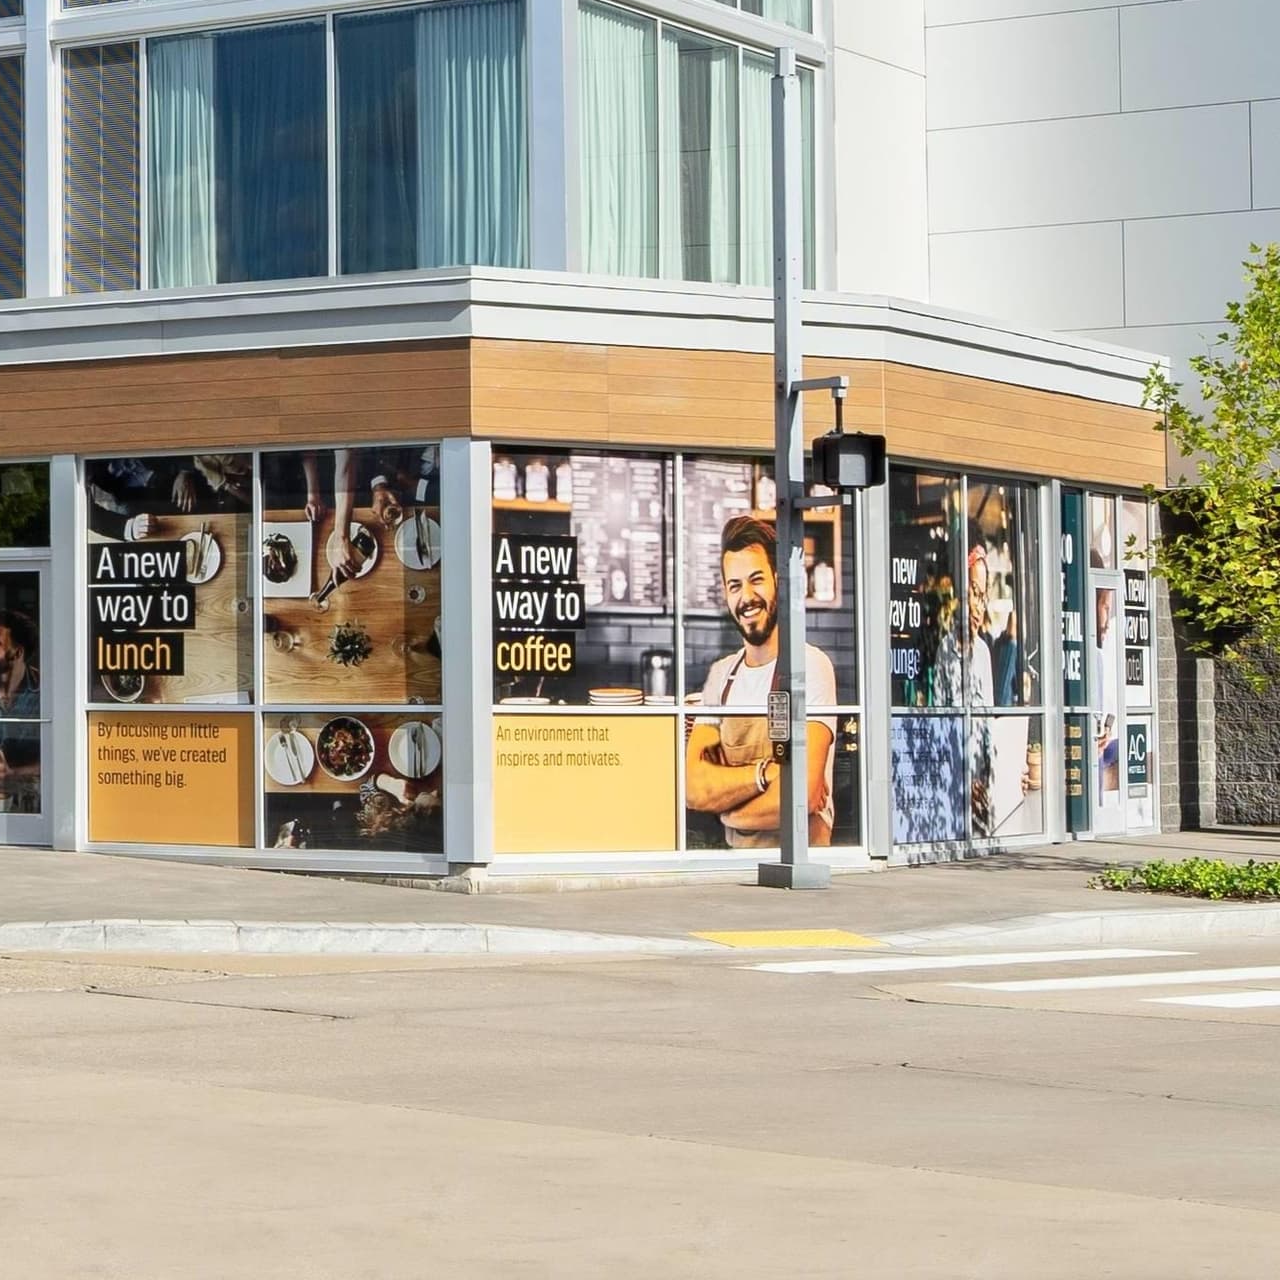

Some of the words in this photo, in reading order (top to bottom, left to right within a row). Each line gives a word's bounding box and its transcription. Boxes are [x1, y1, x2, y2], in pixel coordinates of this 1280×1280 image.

[96, 546, 116, 579] A
[123, 551, 181, 579] new
[495, 537, 515, 574] A
[520, 545, 573, 575] new
[892, 557, 918, 585] new
[1127, 578, 1146, 602] new
[96, 594, 153, 627] way
[160, 590, 189, 622] to
[495, 591, 549, 625] way
[554, 587, 580, 621] to
[889, 599, 907, 632] ay
[908, 597, 921, 628] to
[1061, 611, 1083, 642] ETAIL
[1139, 612, 1149, 641] to
[97, 637, 171, 671] lunch
[496, 635, 572, 672] coffee
[889, 646, 921, 679] ounge
[98, 721, 113, 739] By
[115, 722, 169, 741] focusing
[171, 724, 187, 739] on
[190, 723, 220, 739] little
[496, 725, 512, 742] An
[513, 727, 585, 742] environment
[586, 726, 610, 742] that
[142, 746, 178, 763] we've
[180, 748, 227, 763] created
[496, 750, 540, 768] inspires
[542, 750, 563, 767] and
[1128, 733, 1146, 762] AC
[97, 770, 162, 788] something
[164, 770, 187, 789] big.
